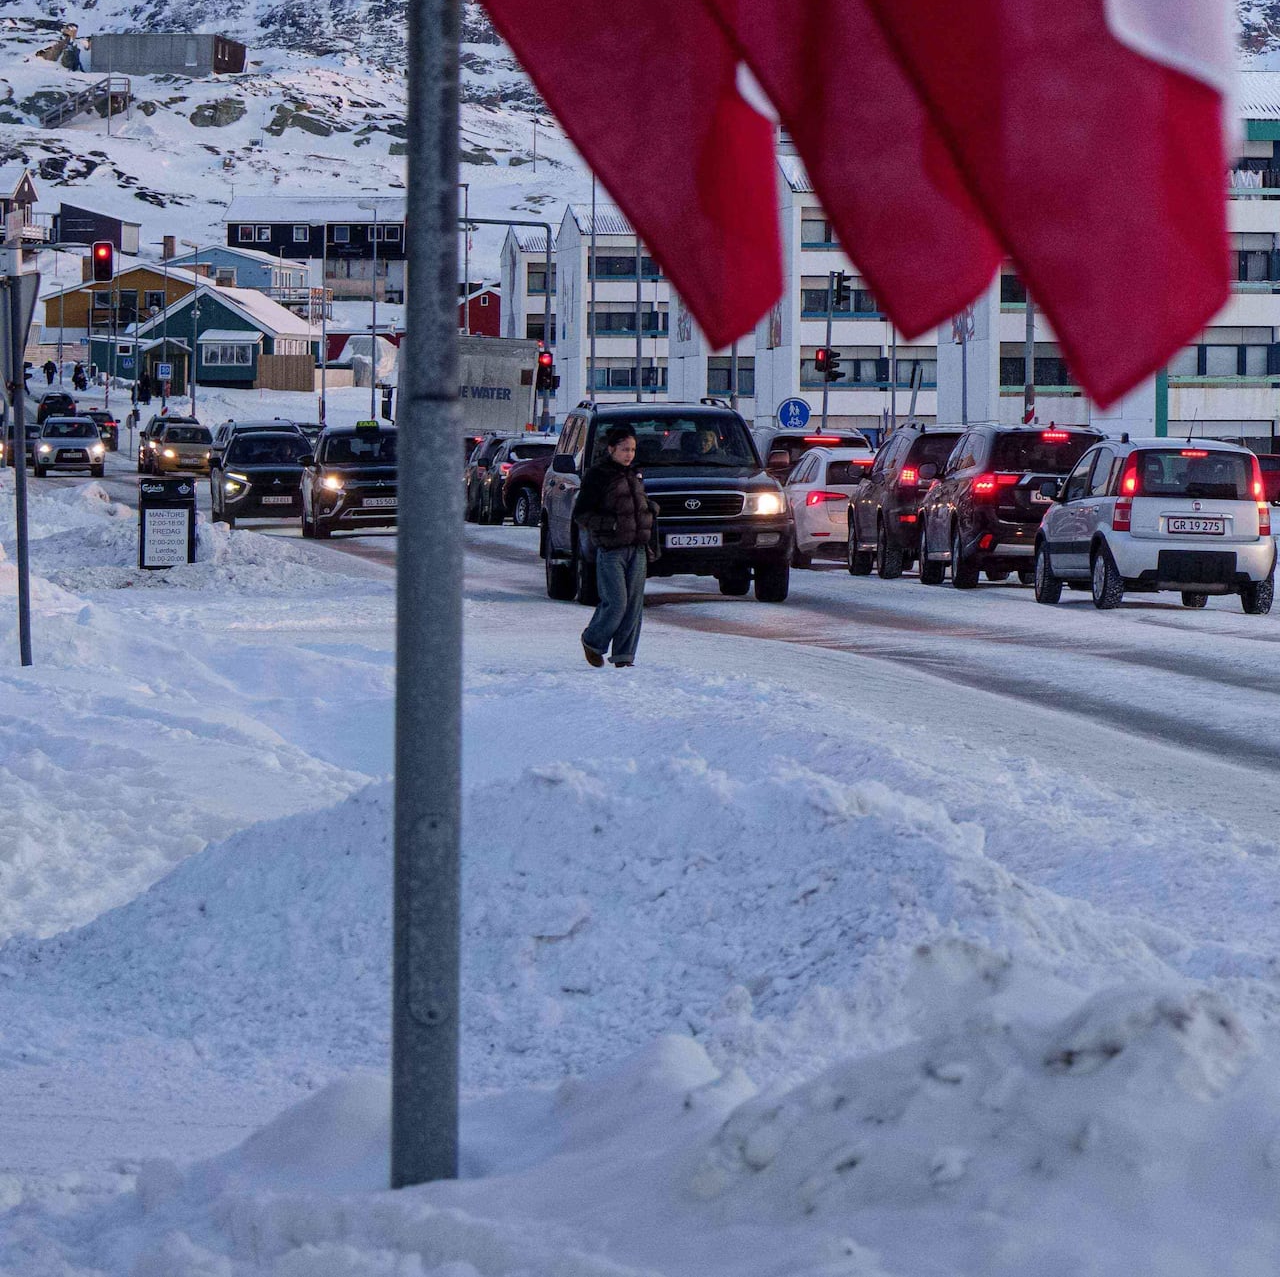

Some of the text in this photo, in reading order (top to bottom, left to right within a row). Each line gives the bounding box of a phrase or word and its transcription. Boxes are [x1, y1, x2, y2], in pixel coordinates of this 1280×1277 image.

[471, 386, 511, 400] WATER
[1173, 520, 1220, 532] GR 19 275
[671, 535, 718, 546] GL 25 179
